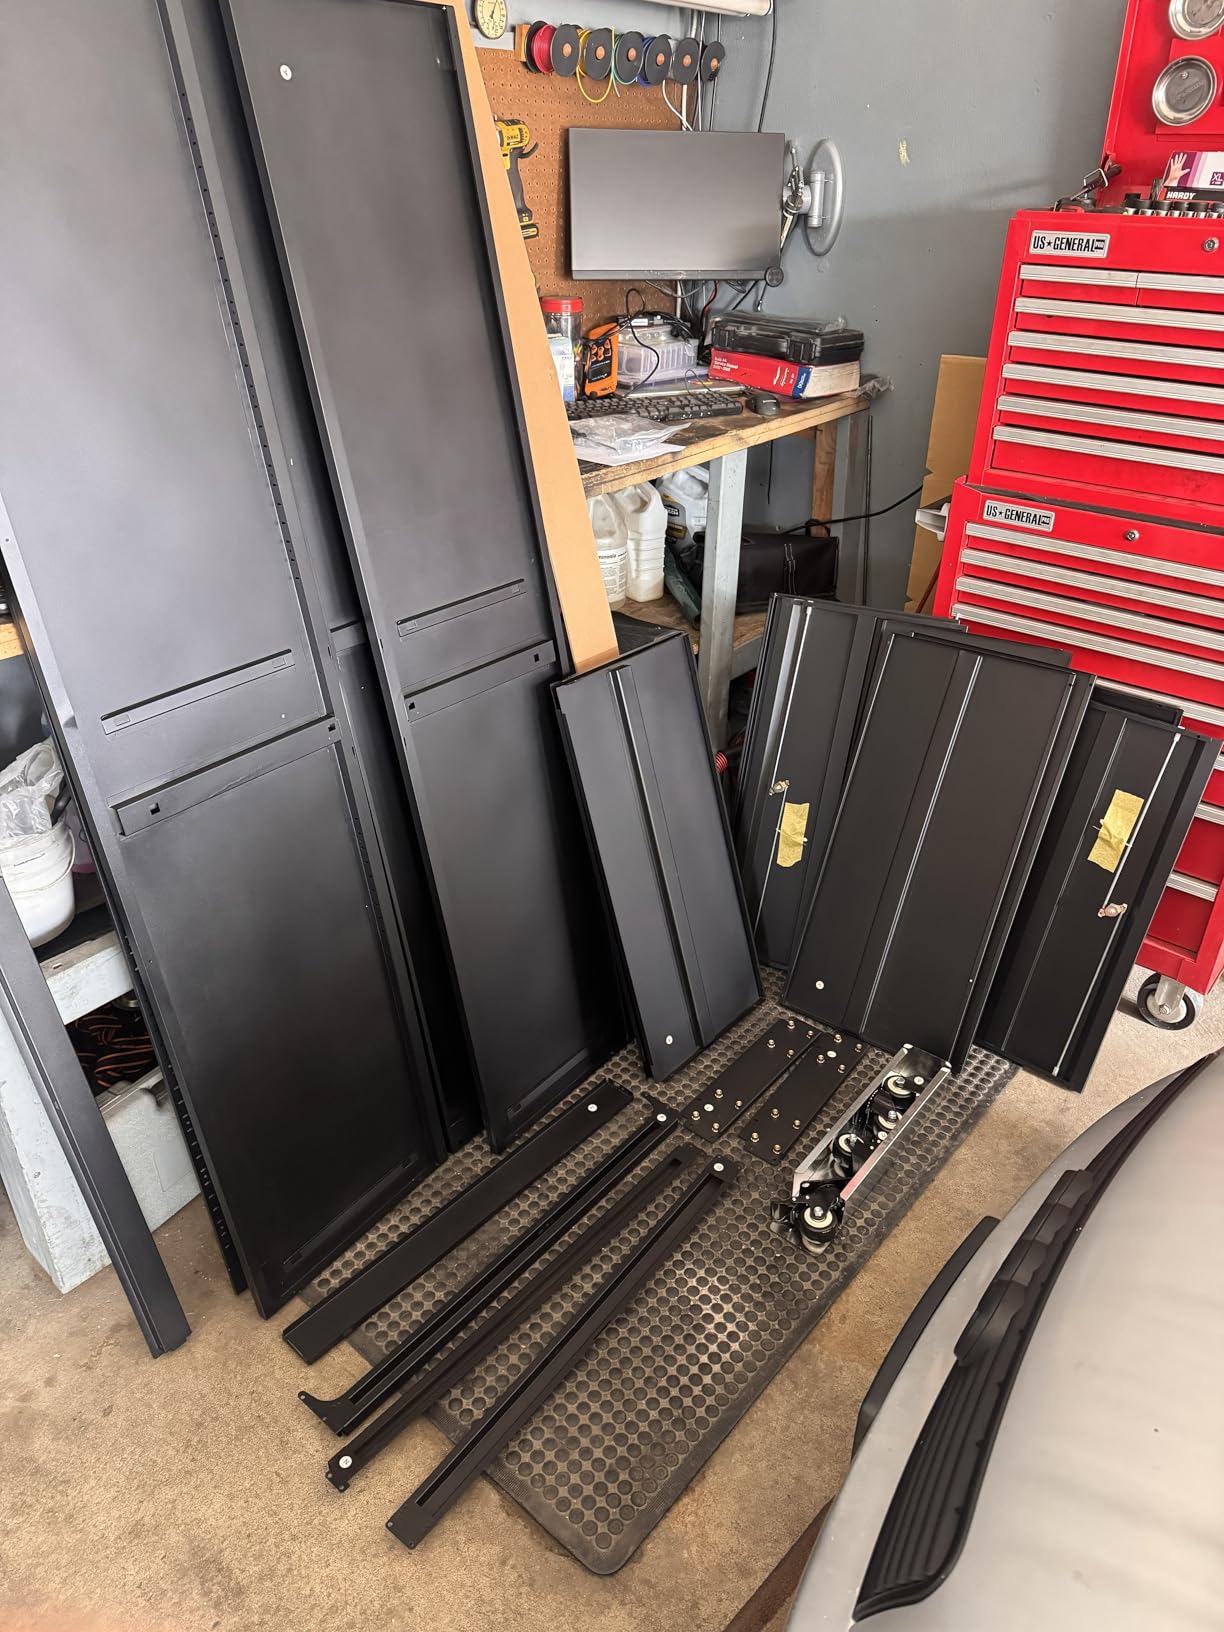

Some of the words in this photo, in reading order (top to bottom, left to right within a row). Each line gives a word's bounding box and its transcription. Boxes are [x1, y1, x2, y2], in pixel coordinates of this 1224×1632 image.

[1212, 173, 1223, 181] XL
[1166, 191, 1196, 200] HARDY
[1033, 235, 1046, 250] US
[1053, 236, 1095, 252] GENERAL
[986, 504, 998, 517] US
[1004, 508, 1042, 526] GENERAL
